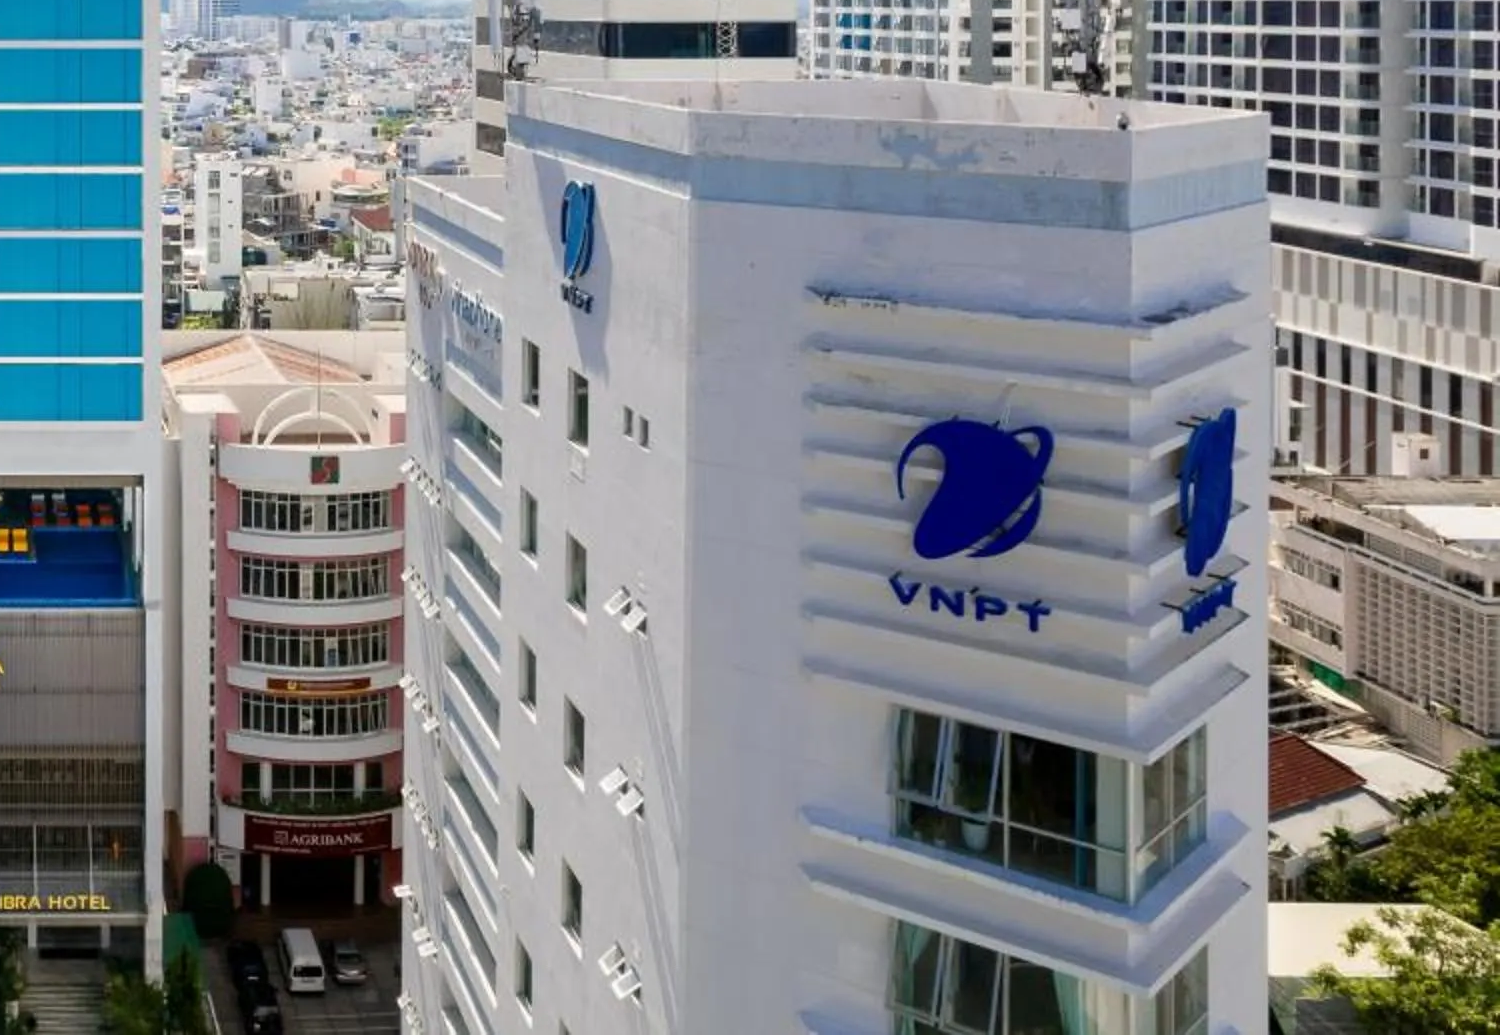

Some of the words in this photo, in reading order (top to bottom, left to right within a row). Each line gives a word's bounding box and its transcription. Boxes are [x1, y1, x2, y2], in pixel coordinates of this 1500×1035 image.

[888, 573, 1052, 633] VNPT
[290, 832, 365, 846] AGRIBANK
[48, 894, 112, 910] HOTEL
